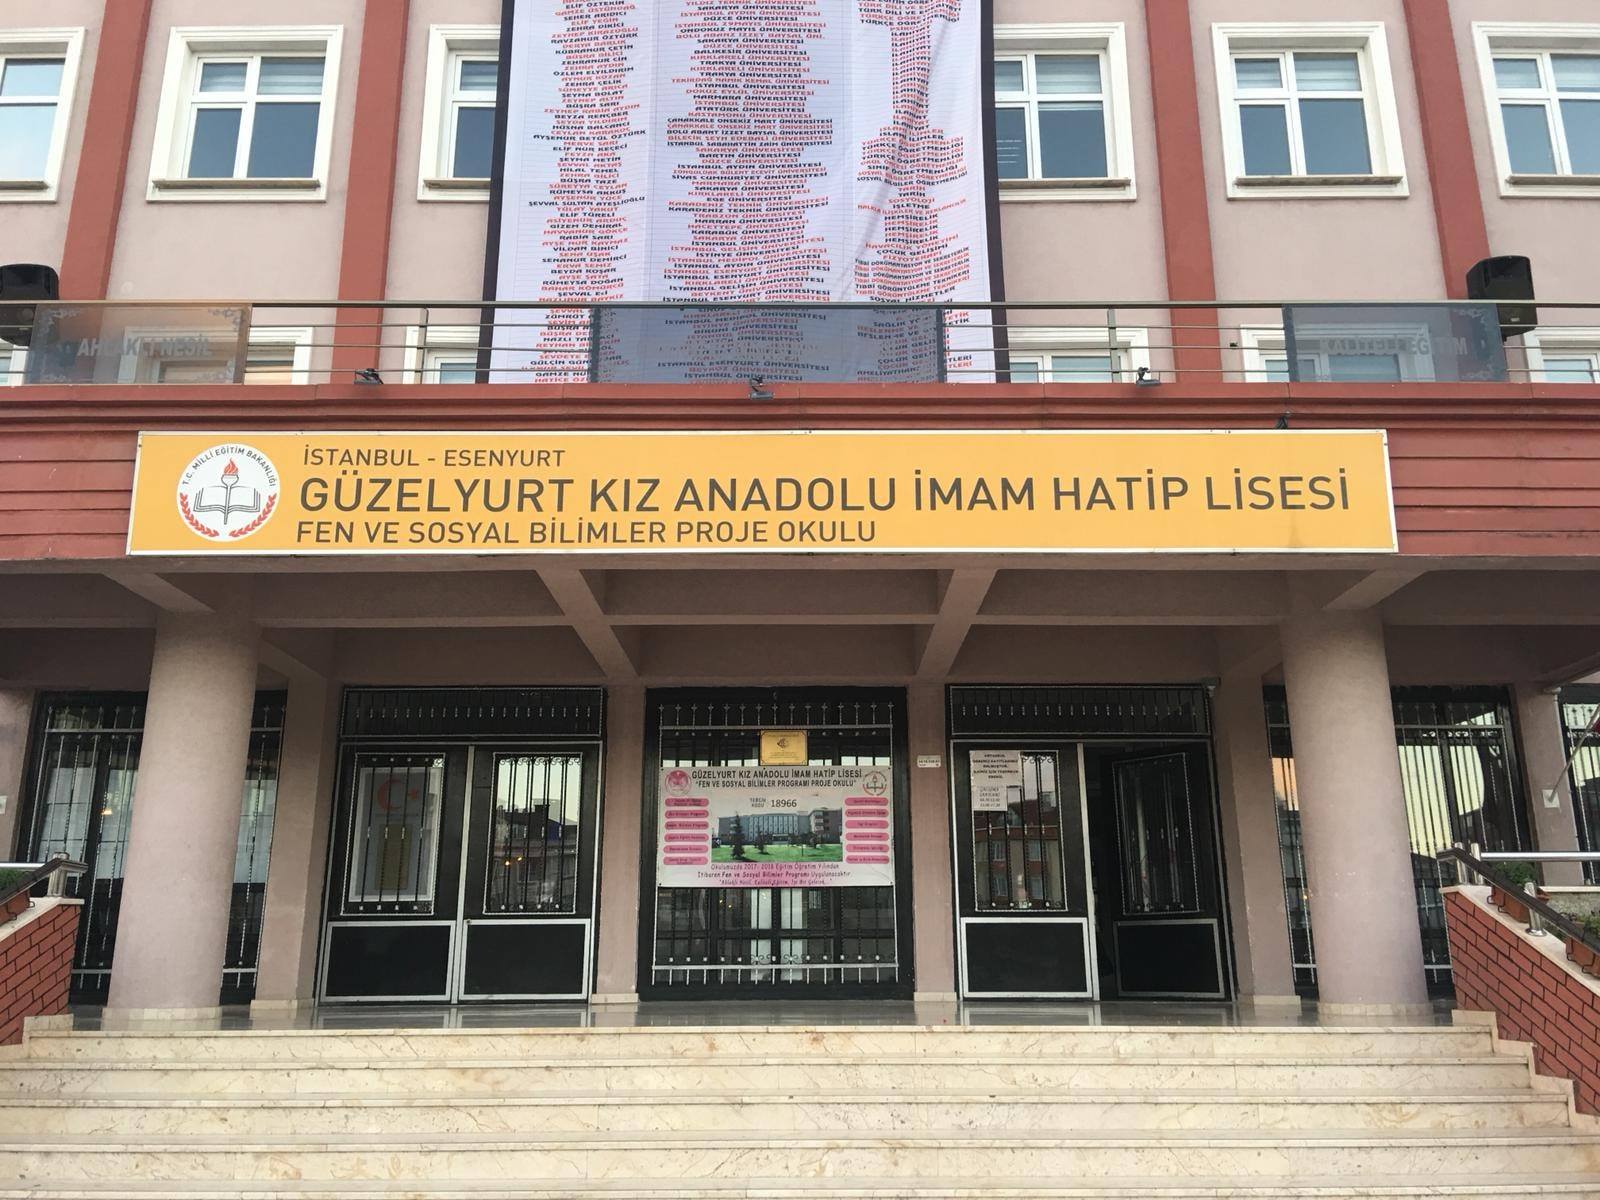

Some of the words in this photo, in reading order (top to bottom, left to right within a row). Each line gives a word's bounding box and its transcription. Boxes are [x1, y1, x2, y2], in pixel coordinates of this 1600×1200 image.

[765, 202, 828, 212] ÜNİVERSİTESİ
[741, 226, 805, 234] ÜNİVERSİTESİ
[741, 235, 804, 245] ÜNİVERSİTESİ
[736, 246, 799, 256] ÜNİVERSİTESİ
[756, 254, 820, 265] ÜNİVERSİTESİ
[760, 277, 824, 285] ÜNİVERSİTESİ
[304, 444, 419, 467] İSTANBUL
[444, 449, 565, 467] ESENYURT
[192, 452, 213, 470] MİLLİ
[215, 446, 245, 456] EĞİTİM
[246, 451, 277, 486] BAKANLIĞI
[300, 469, 574, 513] GÜZELYURT
[591, 478, 660, 512] KIZ
[675, 476, 896, 512] ANADOLU
[914, 469, 1034, 511] İMAM
[1053, 468, 1189, 511] HATİP
[1205, 467, 1350, 511] LİSESİ
[297, 521, 353, 543] FEN
[368, 521, 399, 543] VE
[409, 520, 519, 544] SOSYAL
[530, 514, 666, 543] BİLİMLER
[676, 520, 768, 543] PROJE
[778, 520, 876, 543] OKULU
[692, 769, 736, 779] GÜZELYURT
[739, 770, 751, 778] KIZ
[754, 770, 788, 779] ANADOLU
[792, 769, 811, 778] İMAM
[814, 769, 835, 778] HATİP
[838, 769, 862, 778] LİSESİ
[748, 779, 776, 787] BİLİMLER
[771, 799, 797, 807] 18966
